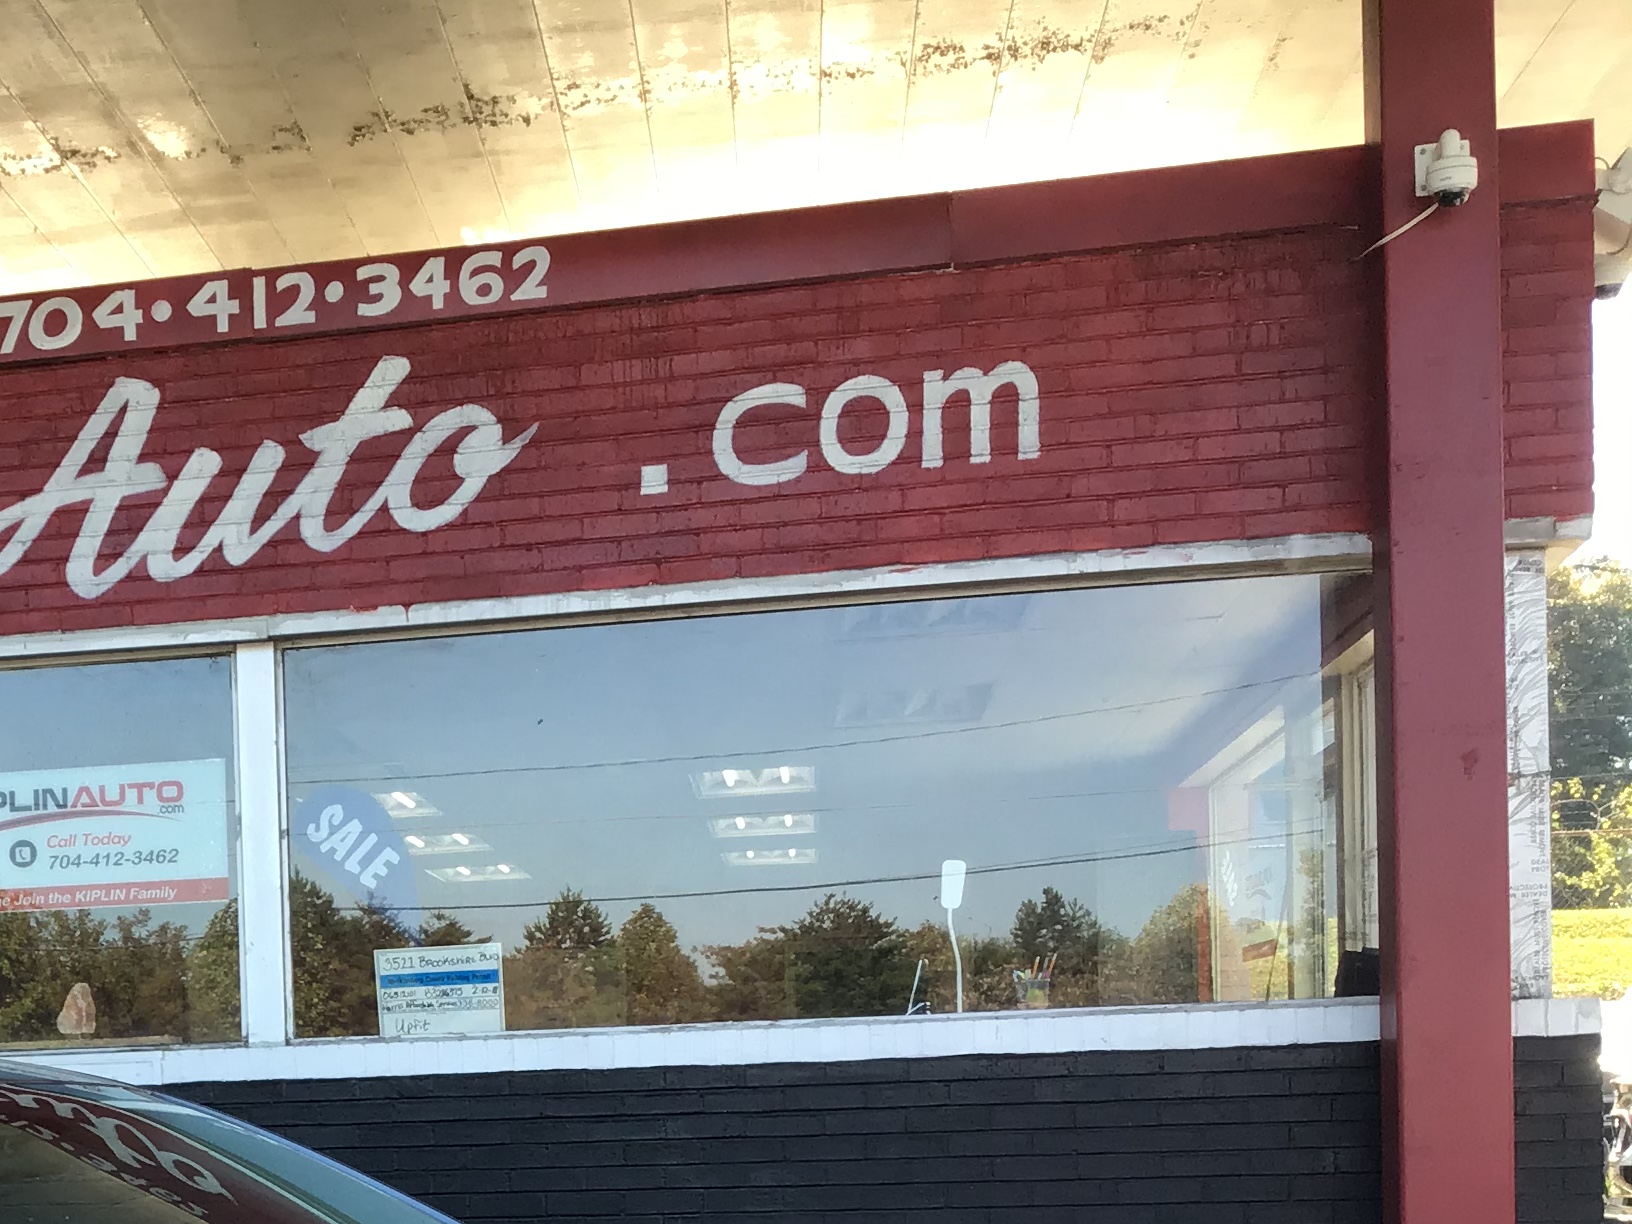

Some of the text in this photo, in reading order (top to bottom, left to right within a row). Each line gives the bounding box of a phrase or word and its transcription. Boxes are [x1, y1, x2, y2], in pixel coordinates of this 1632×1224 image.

[46, 831, 132, 848] Call Today
[306, 803, 401, 890] SALE
[48, 848, 180, 870] 704-412-3462
[13, 893, 45, 906] Join
[48, 892, 72, 904] the
[74, 888, 126, 903] KIPLIN
[129, 886, 178, 901] Family
[383, 955, 415, 971] 3521
